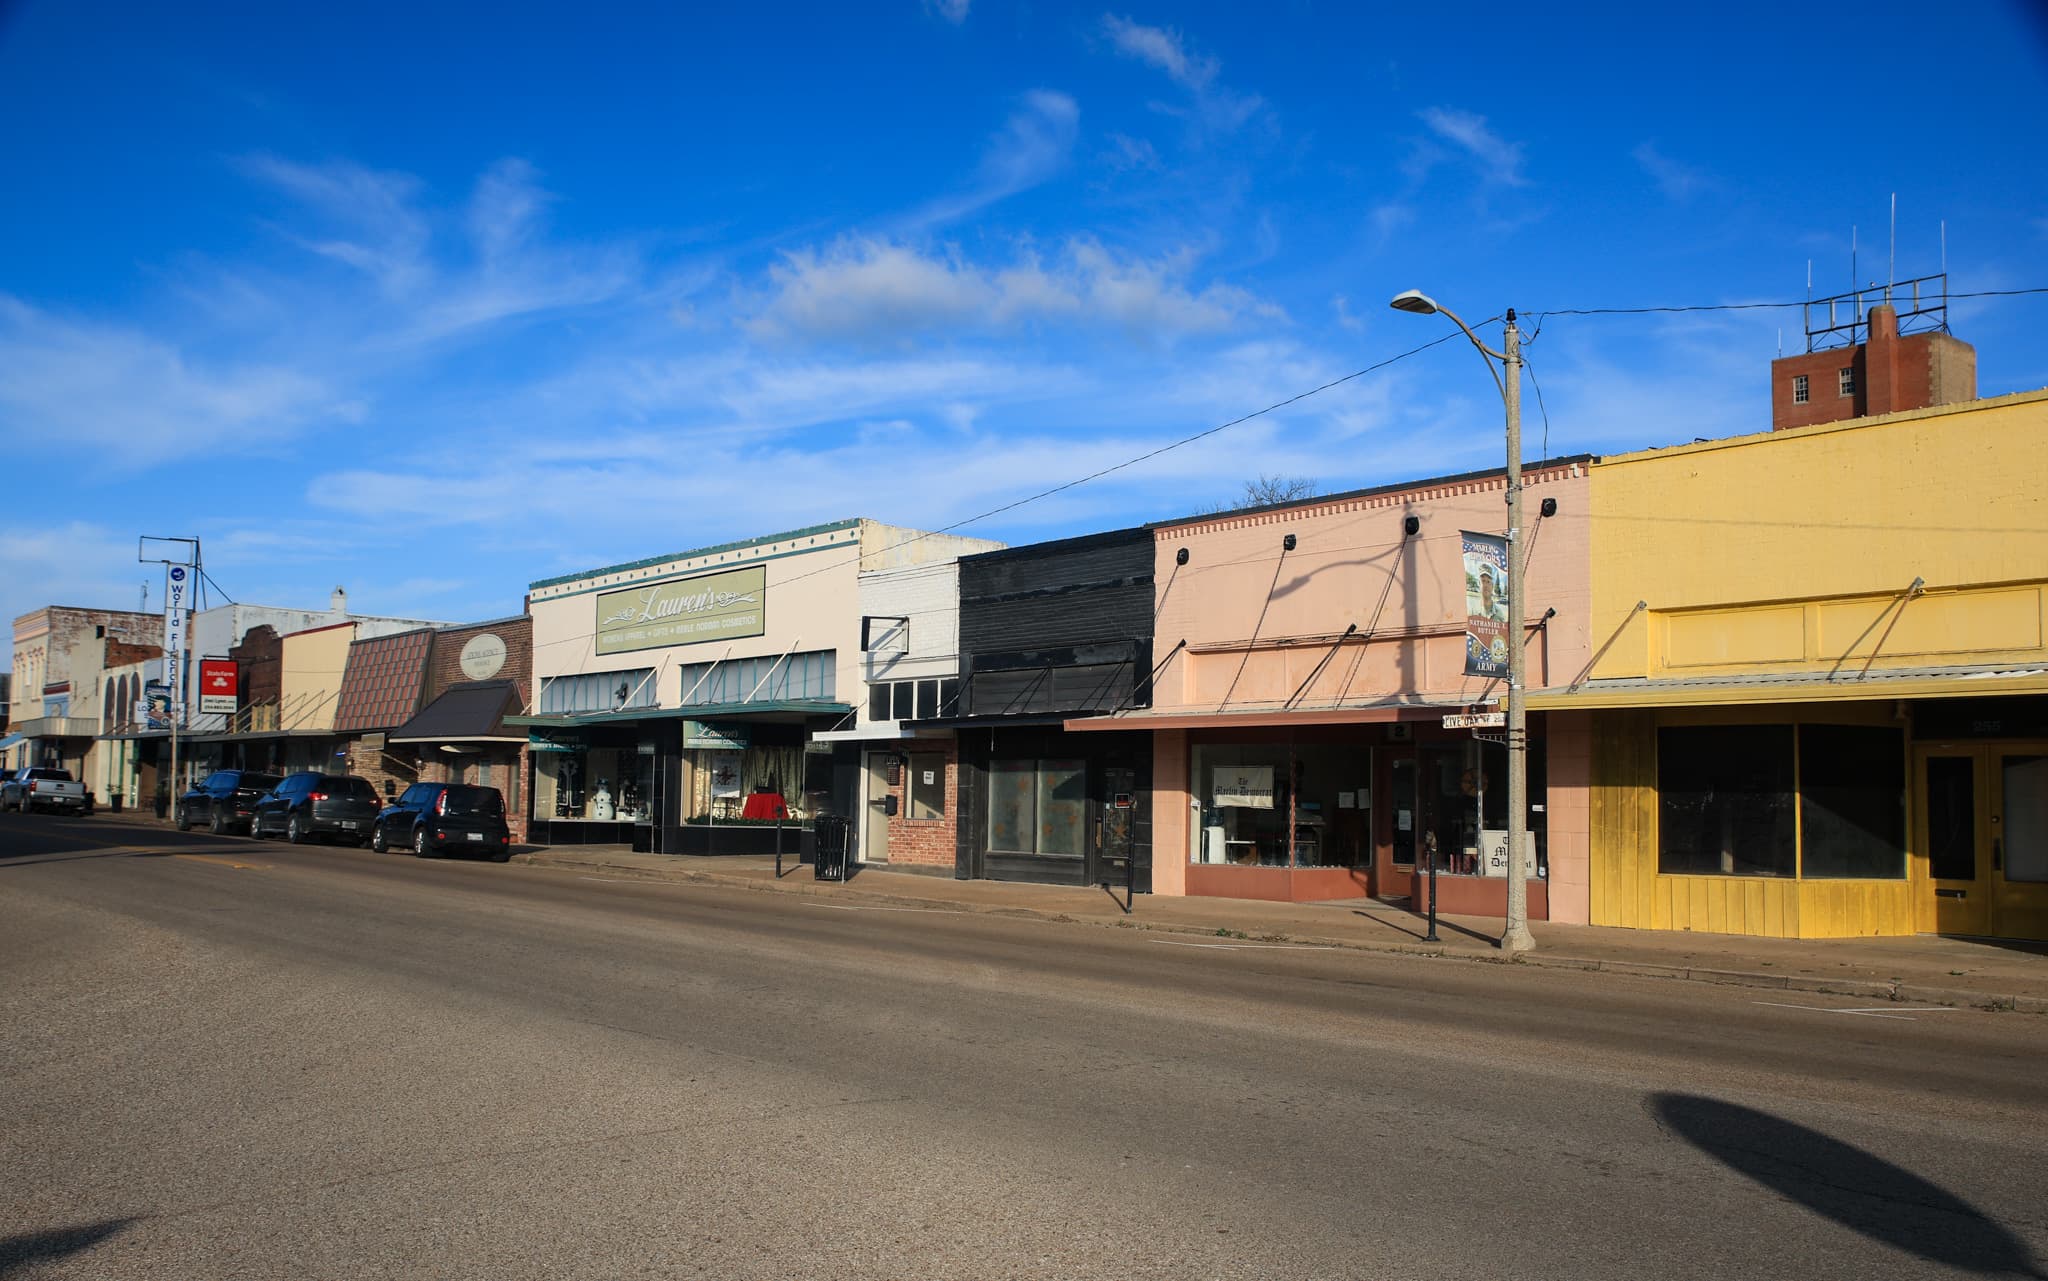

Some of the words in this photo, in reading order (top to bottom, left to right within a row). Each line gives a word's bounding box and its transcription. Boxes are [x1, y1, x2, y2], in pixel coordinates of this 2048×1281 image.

[171, 585, 183, 627] World
[638, 586, 715, 623] Lauren's
[721, 615, 757, 628] COSMETICS
[1470, 619, 1501, 629] NATHANIEL
[1477, 627, 1499, 635] BUTLER
[1475, 662, 1498, 672] ARMY
[1445, 715, 1462, 728] LIVE
[1238, 776, 1249, 785] The
[1215, 785, 1238, 796] Marlin
[1239, 786, 1272, 797] Democrat
